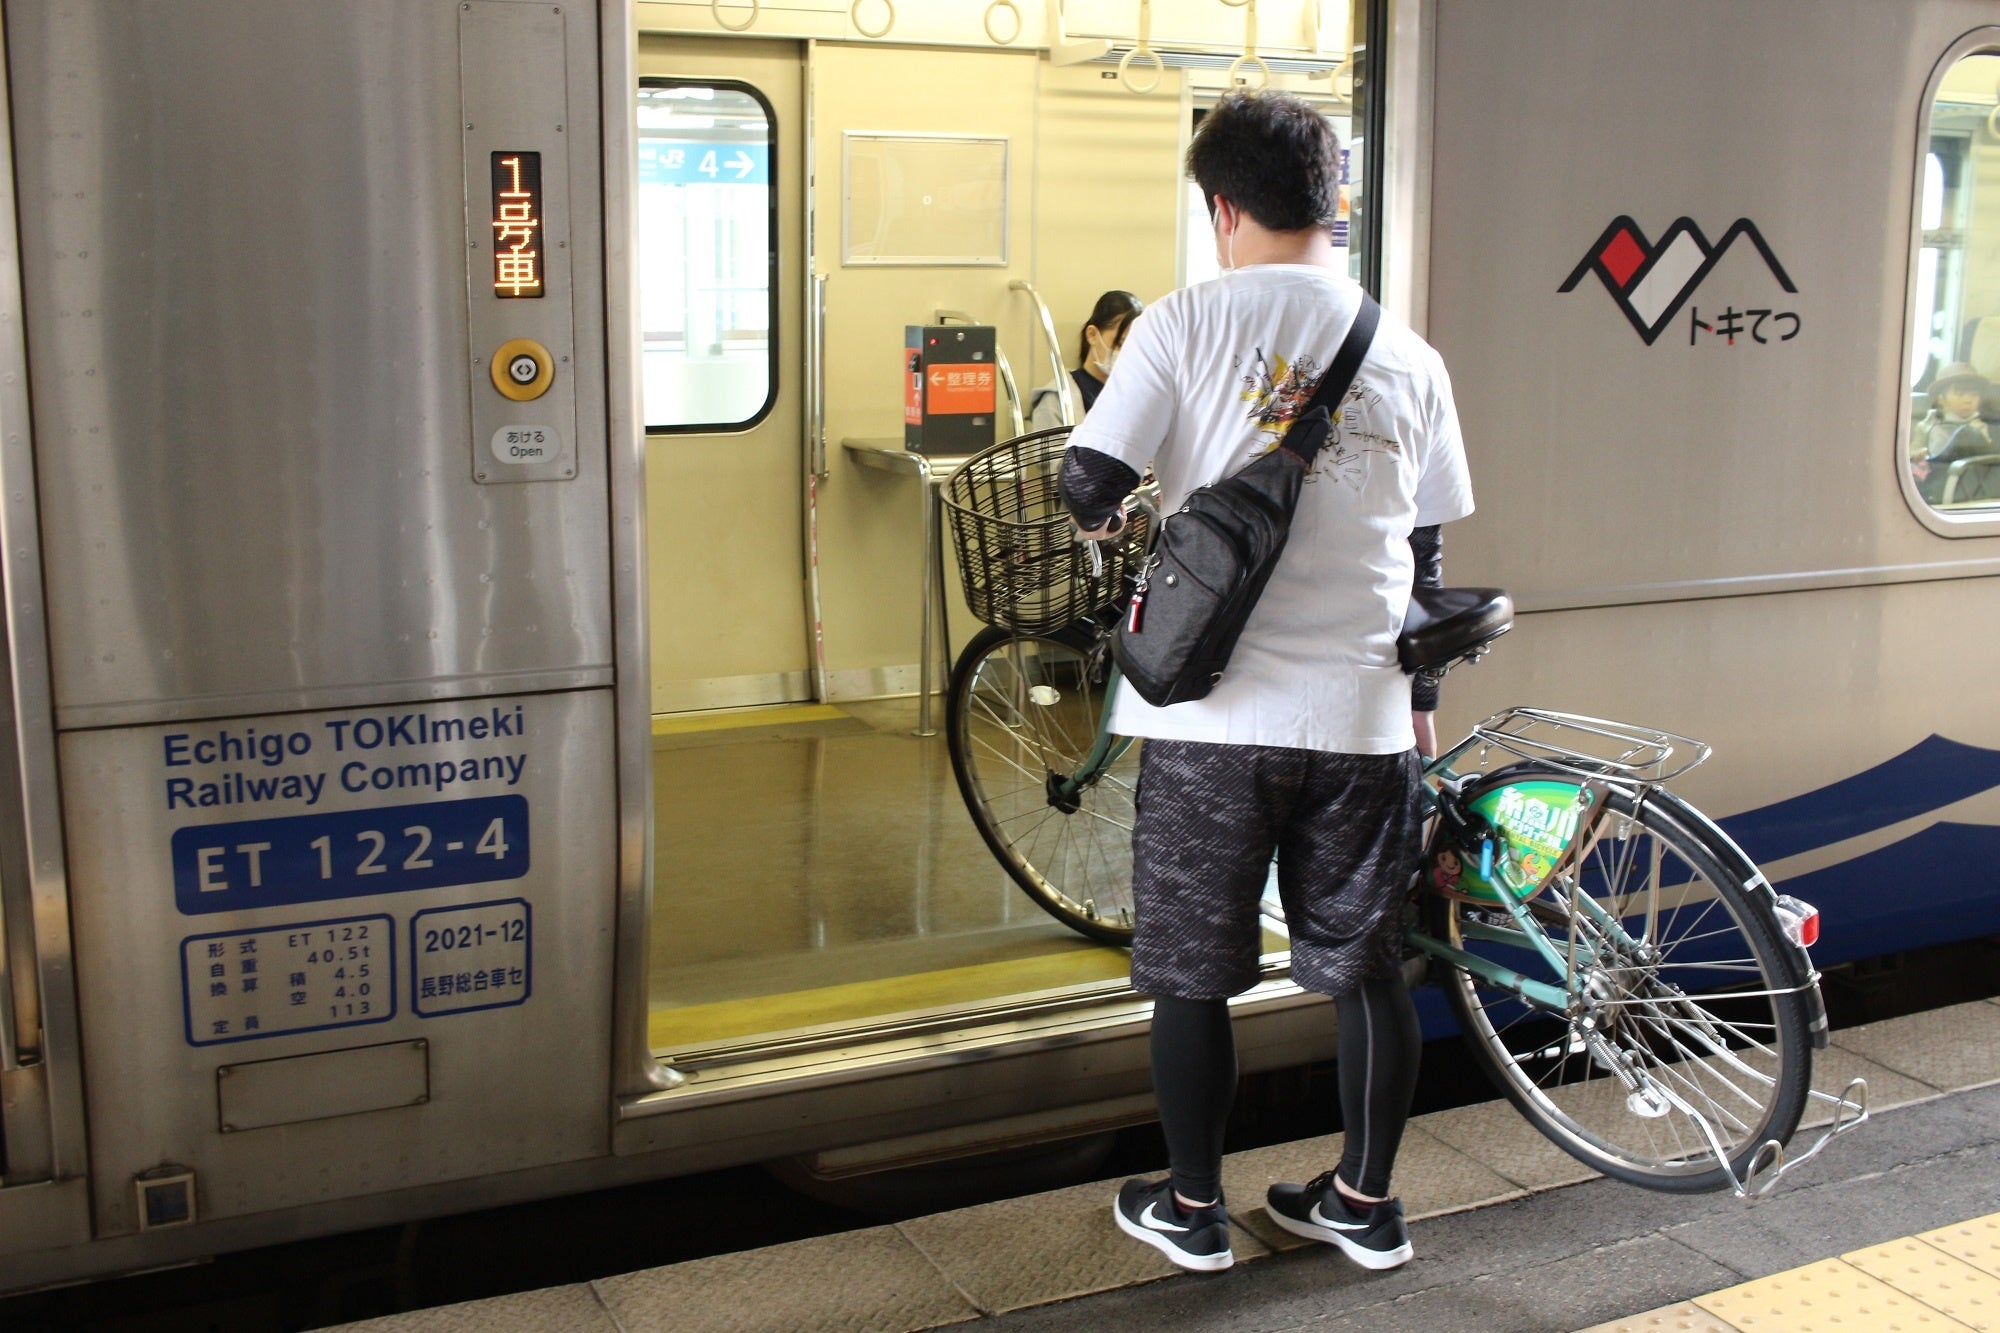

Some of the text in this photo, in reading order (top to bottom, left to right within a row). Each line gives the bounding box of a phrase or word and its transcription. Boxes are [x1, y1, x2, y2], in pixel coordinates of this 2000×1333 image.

[698, 150, 719, 178] 4
[492, 157, 540, 296] 1号車
[1691, 306, 1801, 346] トキてつ
[506, 431, 545, 444] あける
[510, 446, 543, 459] Open
[164, 705, 524, 767] Echigo TOKImeki
[166, 753, 527, 810] Railway Company
[197, 817, 509, 893] ET 122-4
[425, 919, 525, 953] 2021-12
[335, 964, 369, 979] 4.5
[421, 966, 523, 999] 長野総合車セ
[335, 983, 371, 998] 4.0
[331, 1002, 370, 1017] 113
